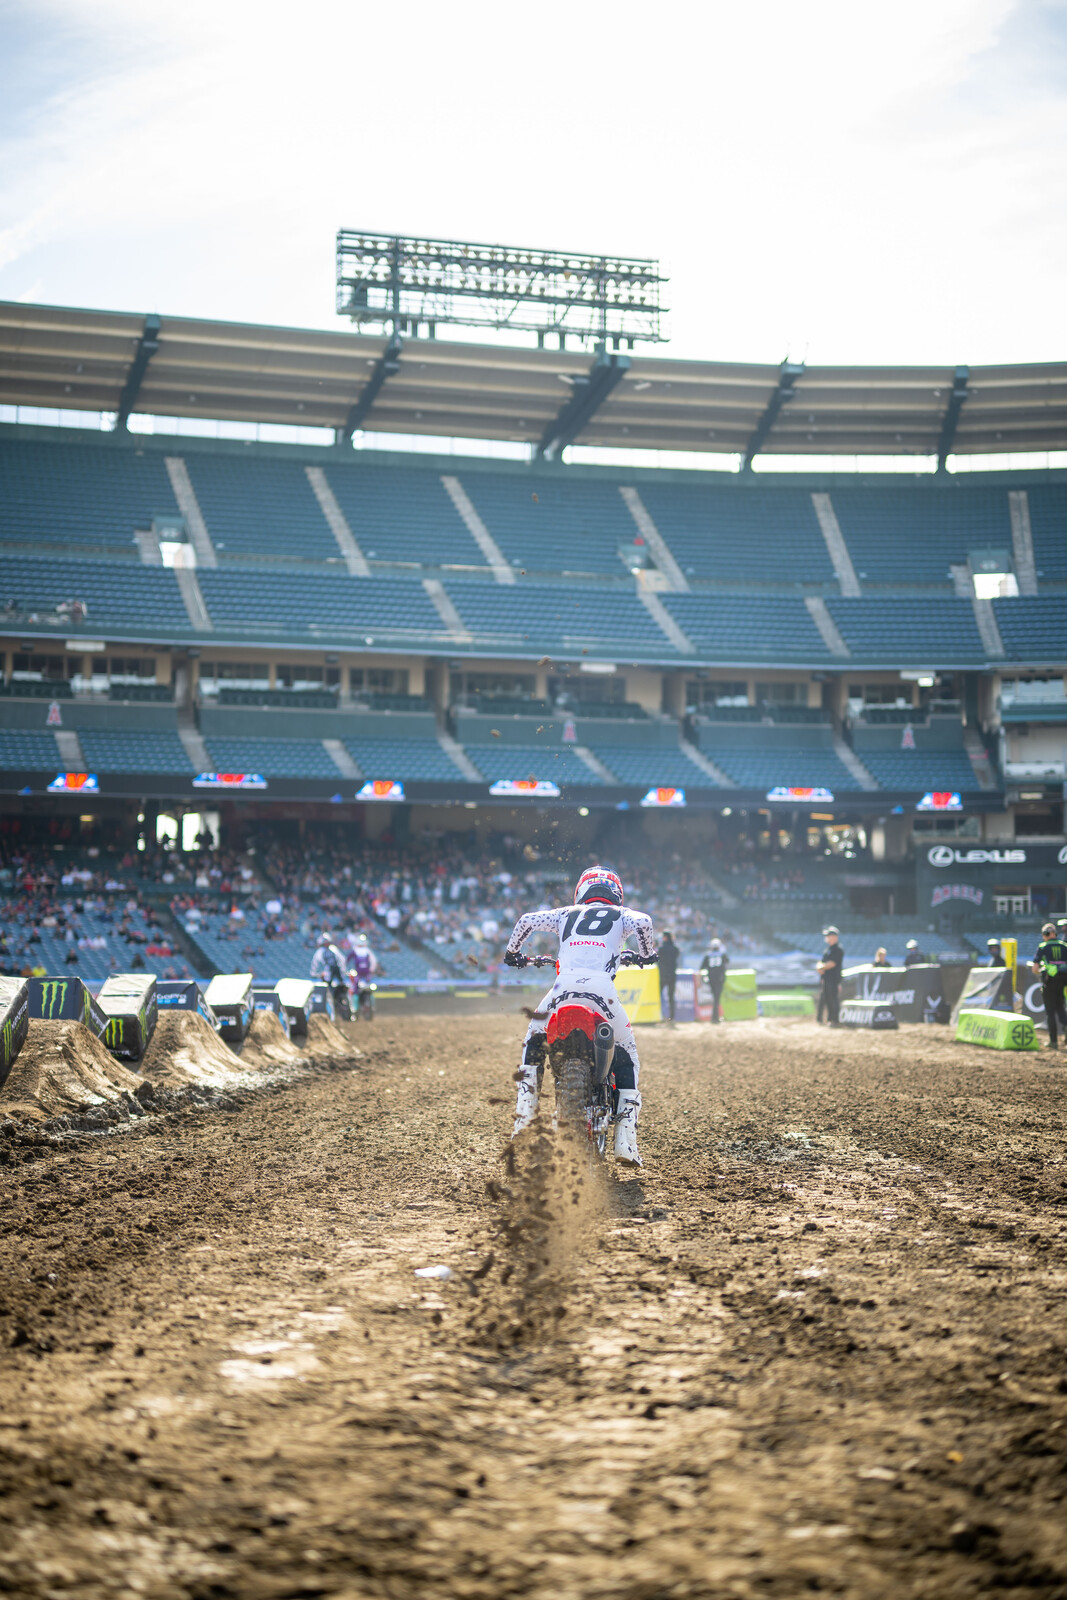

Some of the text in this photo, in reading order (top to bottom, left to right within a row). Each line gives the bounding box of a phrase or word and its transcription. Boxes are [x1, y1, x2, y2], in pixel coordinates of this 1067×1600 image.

[954, 849, 1027, 863] LEXUS
[587, 877, 614, 887] JETT
[930, 884, 984, 907] ANGELS
[562, 906, 621, 942] 18
[569, 940, 607, 948] HONDA
[547, 990, 615, 1020] alpinestars
